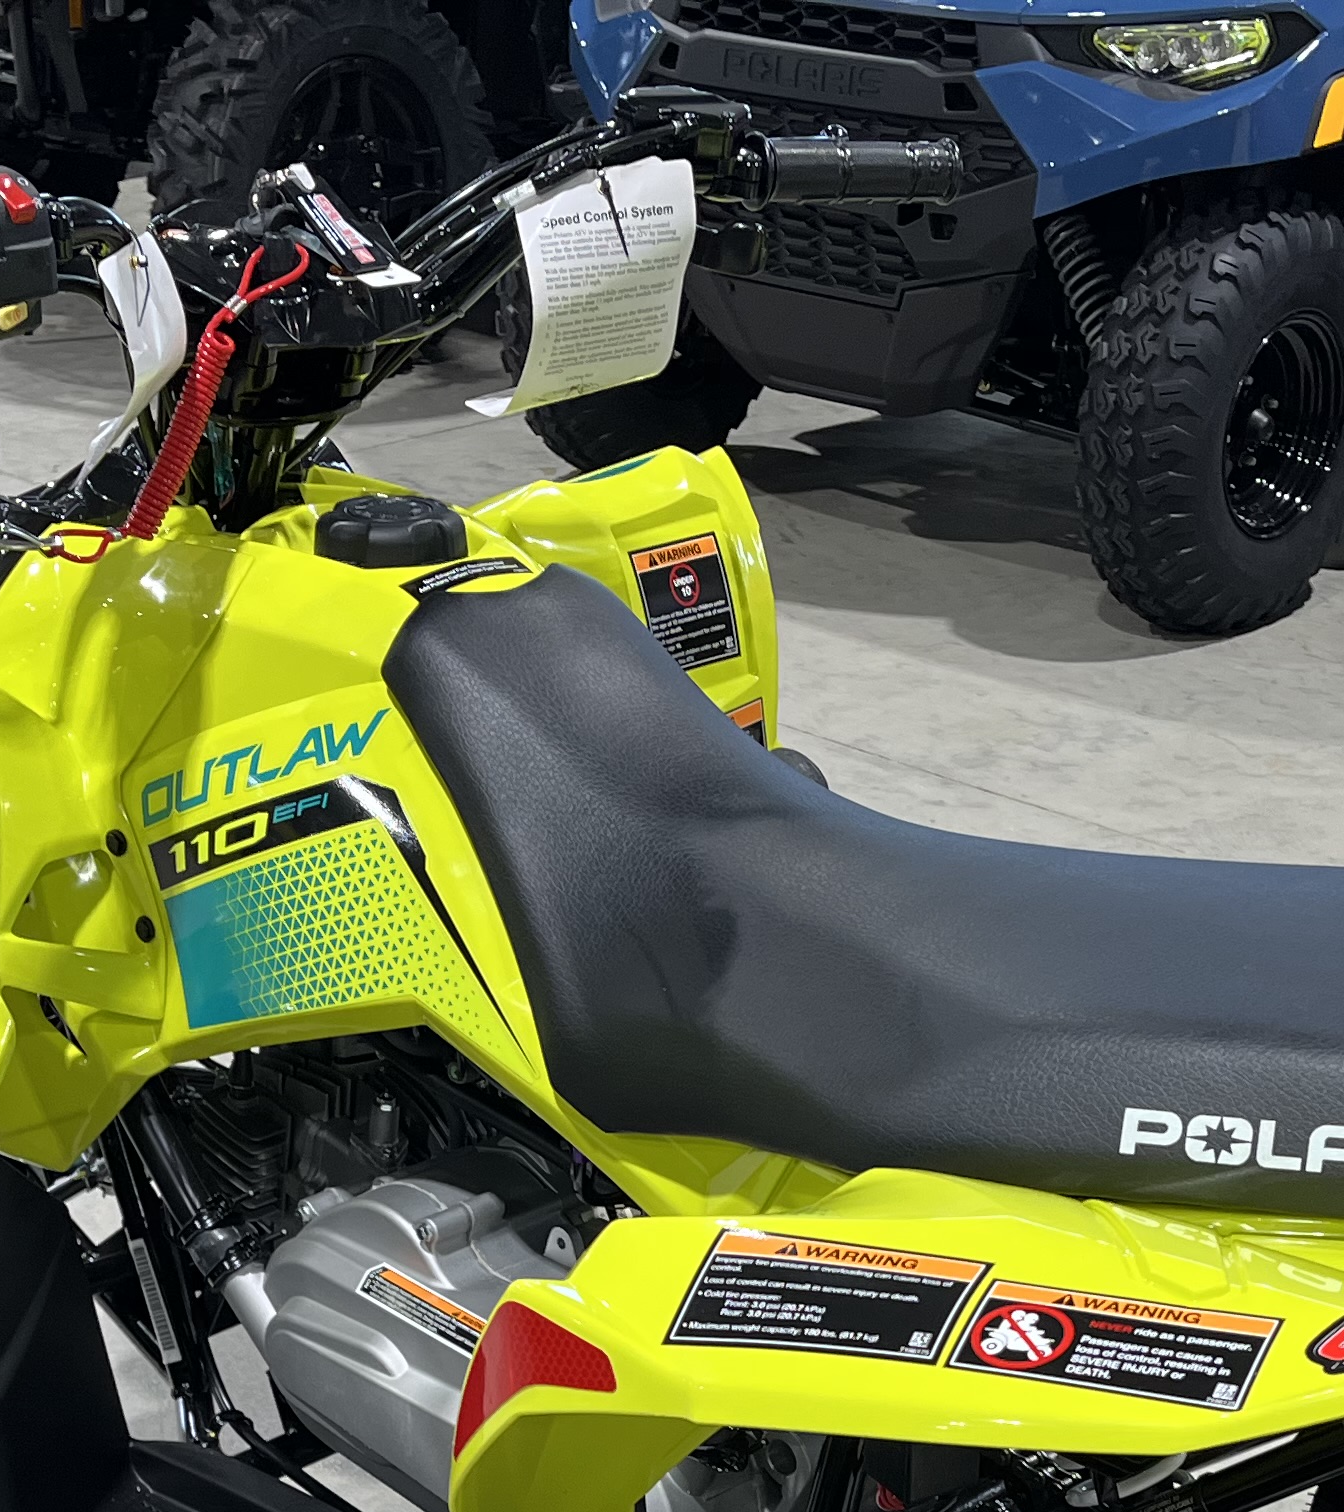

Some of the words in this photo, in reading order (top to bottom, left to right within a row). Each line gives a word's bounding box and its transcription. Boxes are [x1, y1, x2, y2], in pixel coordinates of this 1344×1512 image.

[723, 49, 885, 97] POLARIS
[541, 212, 580, 230] Speed
[584, 209, 628, 223] Contol
[631, 205, 674, 221] System
[658, 543, 702, 563] WARNING
[681, 587, 691, 598] 10
[141, 707, 392, 828] OUTLAW
[167, 810, 270, 875] 110
[272, 791, 330, 824] EFI
[801, 1244, 921, 1270] WARNING
[1079, 1296, 1204, 1324] WARNING
[1077, 1333, 1153, 1354] Passengers
[1148, 1347, 1175, 1357] can
[1173, 1350, 1215, 1363] cause
[1213, 1356, 1224, 1365] a
[1131, 1327, 1160, 1338] ride
[1157, 1331, 1177, 1340] as
[1175, 1334, 1186, 1342] a
[1184, 1335, 1256, 1353] passenger.
[1063, 1362, 1115, 1379] DEATH.
[1068, 1354, 1122, 1370] SEVERE
[1119, 1362, 1171, 1377] INJURY
[1168, 1370, 1186, 1380] or
[1073, 1345, 1102, 1356] loss
[1099, 1348, 1116, 1358] of
[1161, 1358, 1219, 1376] resulting
[1216, 1366, 1233, 1376] in
